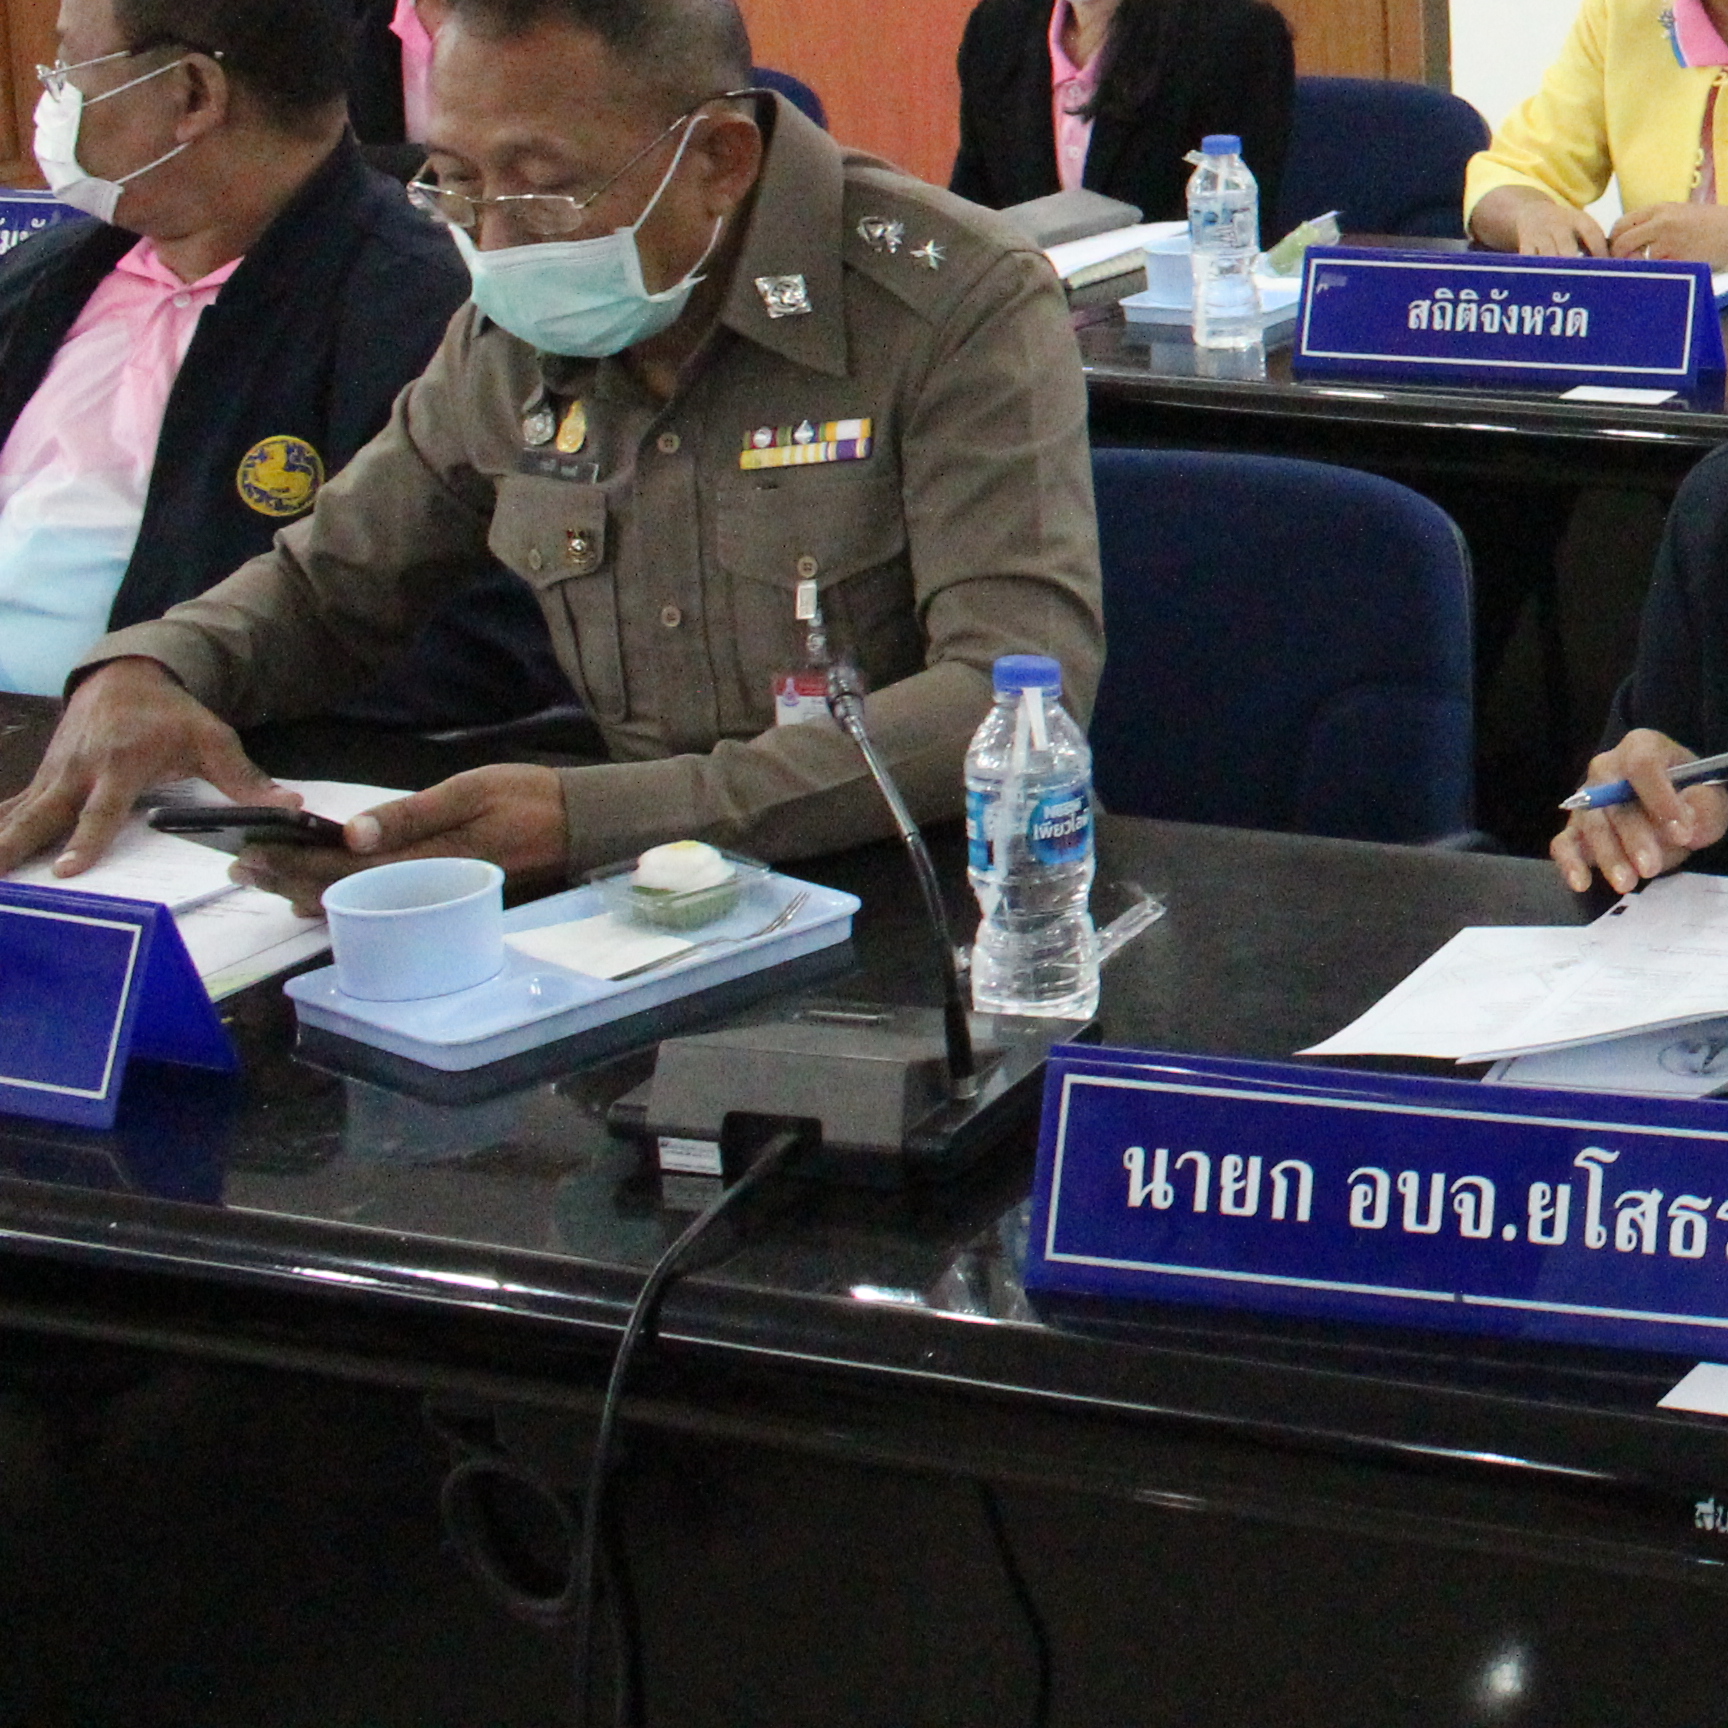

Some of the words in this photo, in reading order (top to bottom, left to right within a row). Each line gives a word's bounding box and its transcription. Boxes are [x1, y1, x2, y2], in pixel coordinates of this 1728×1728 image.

[1406, 286, 1590, 340] สถิติจังหวัด
[1122, 1143, 1314, 1223] นายก
